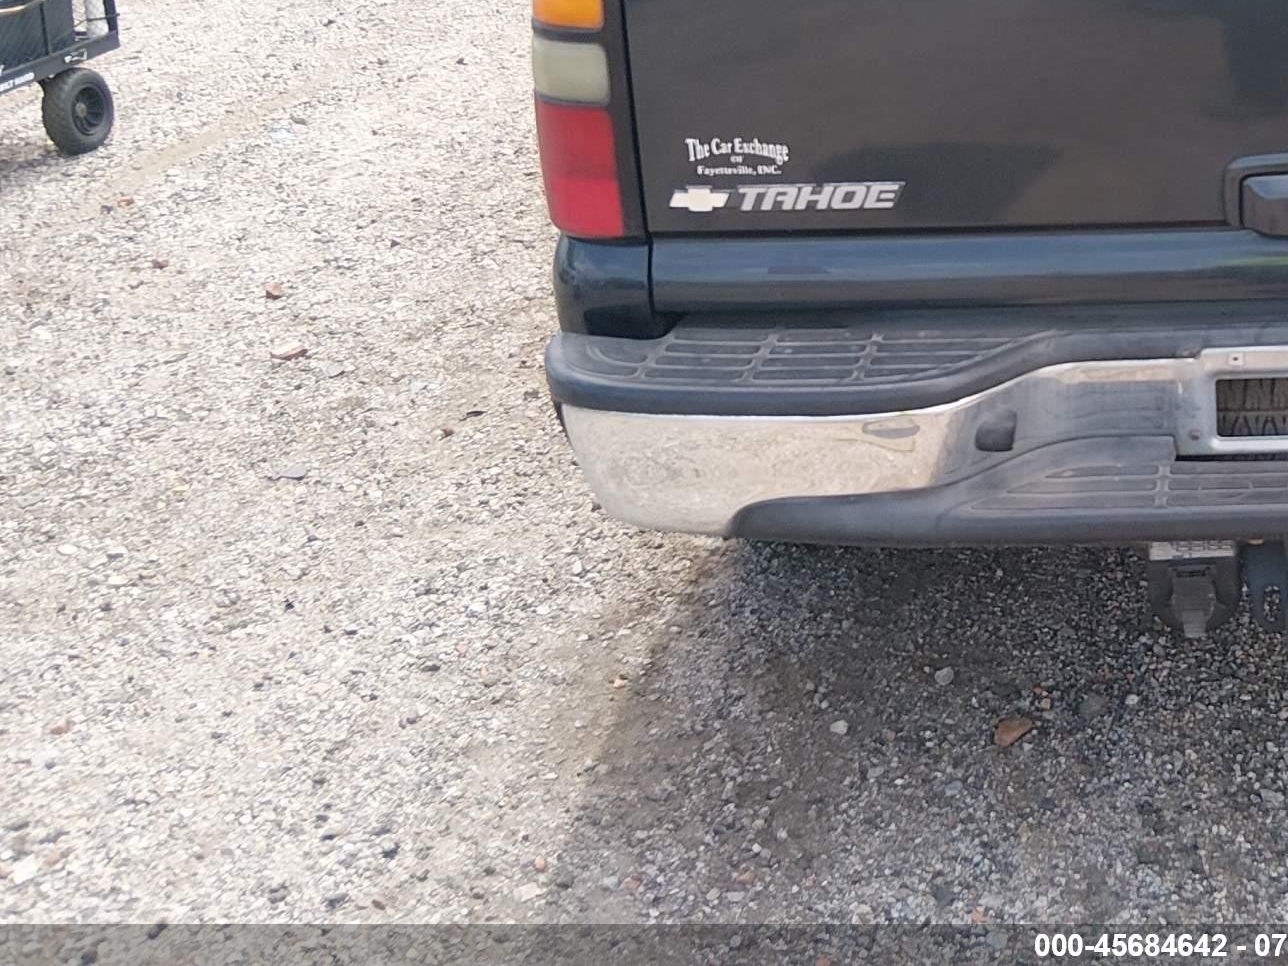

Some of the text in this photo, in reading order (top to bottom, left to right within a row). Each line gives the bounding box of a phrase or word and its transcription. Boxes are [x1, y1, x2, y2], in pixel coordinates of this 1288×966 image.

[685, 138, 789, 165] The Car Exchange
[697, 165, 756, 176] Fayetteville,
[738, 181, 906, 212] TAHOE
